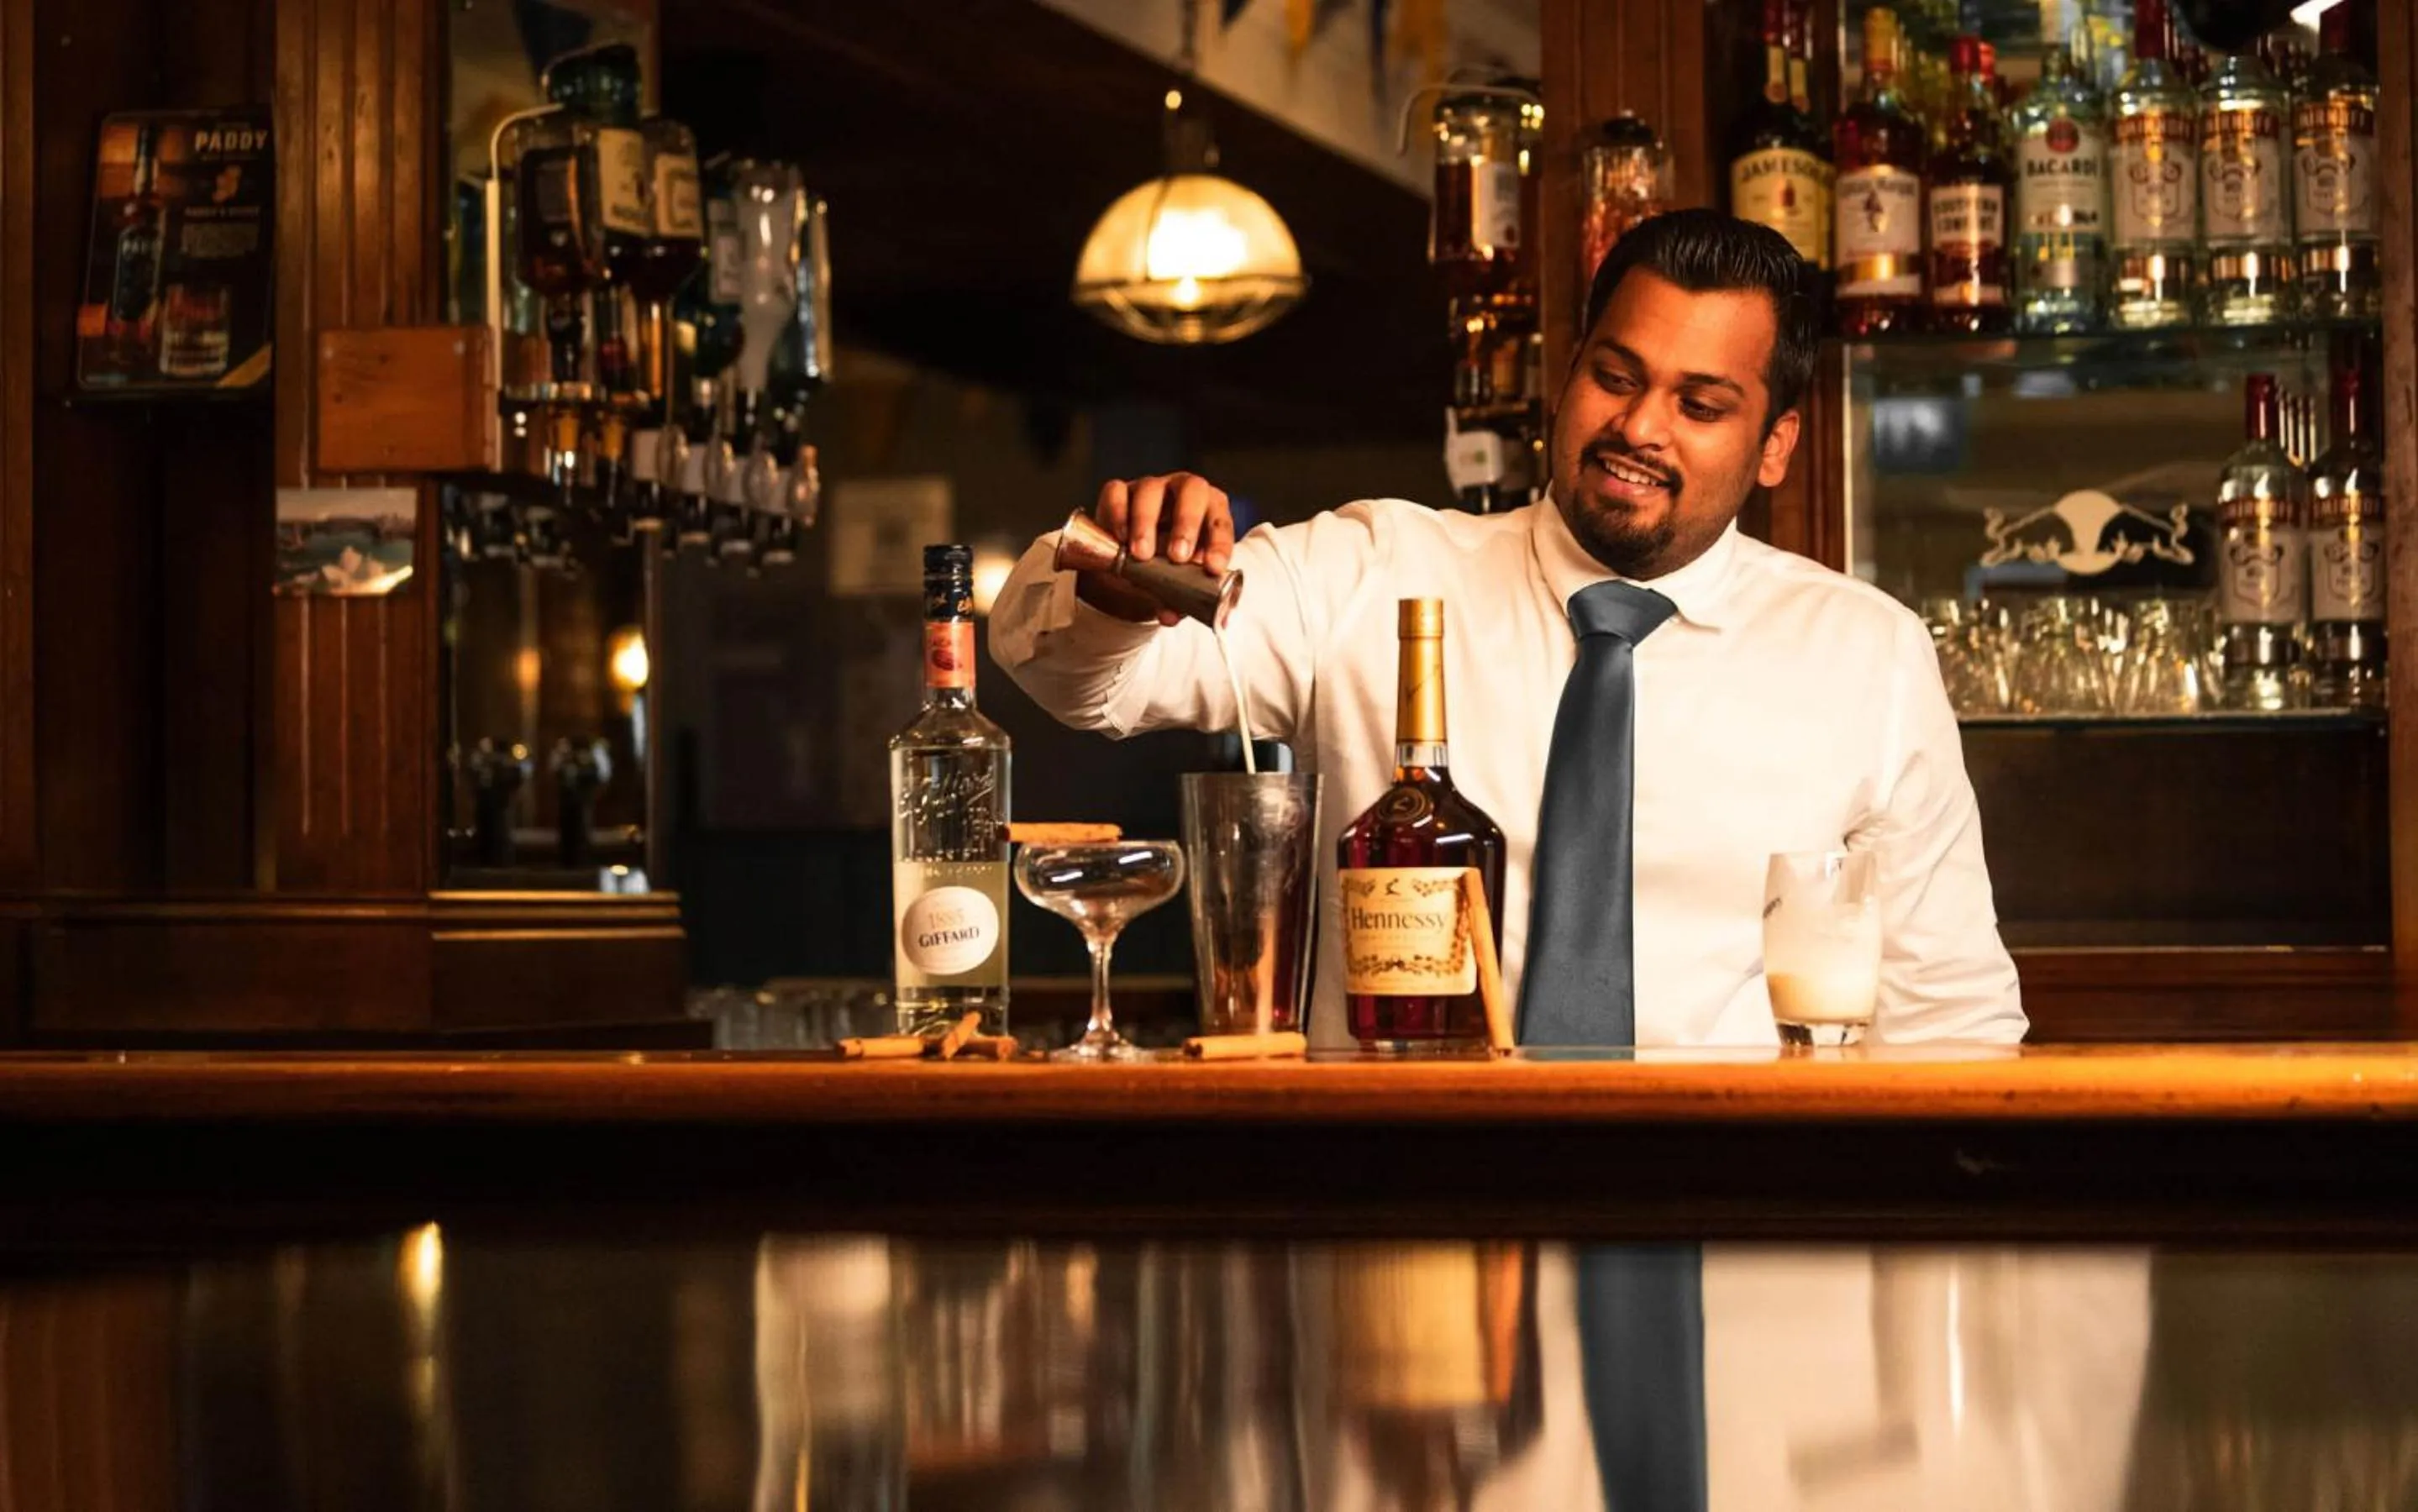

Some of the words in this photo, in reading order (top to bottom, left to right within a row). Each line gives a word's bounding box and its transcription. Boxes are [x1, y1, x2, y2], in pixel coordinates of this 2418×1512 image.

[195, 129, 269, 152] PADDY
[2026, 157, 2098, 177] BACARDI
[1352, 906, 1447, 934] Hennessy
[918, 927, 980, 948] GIFFARD
